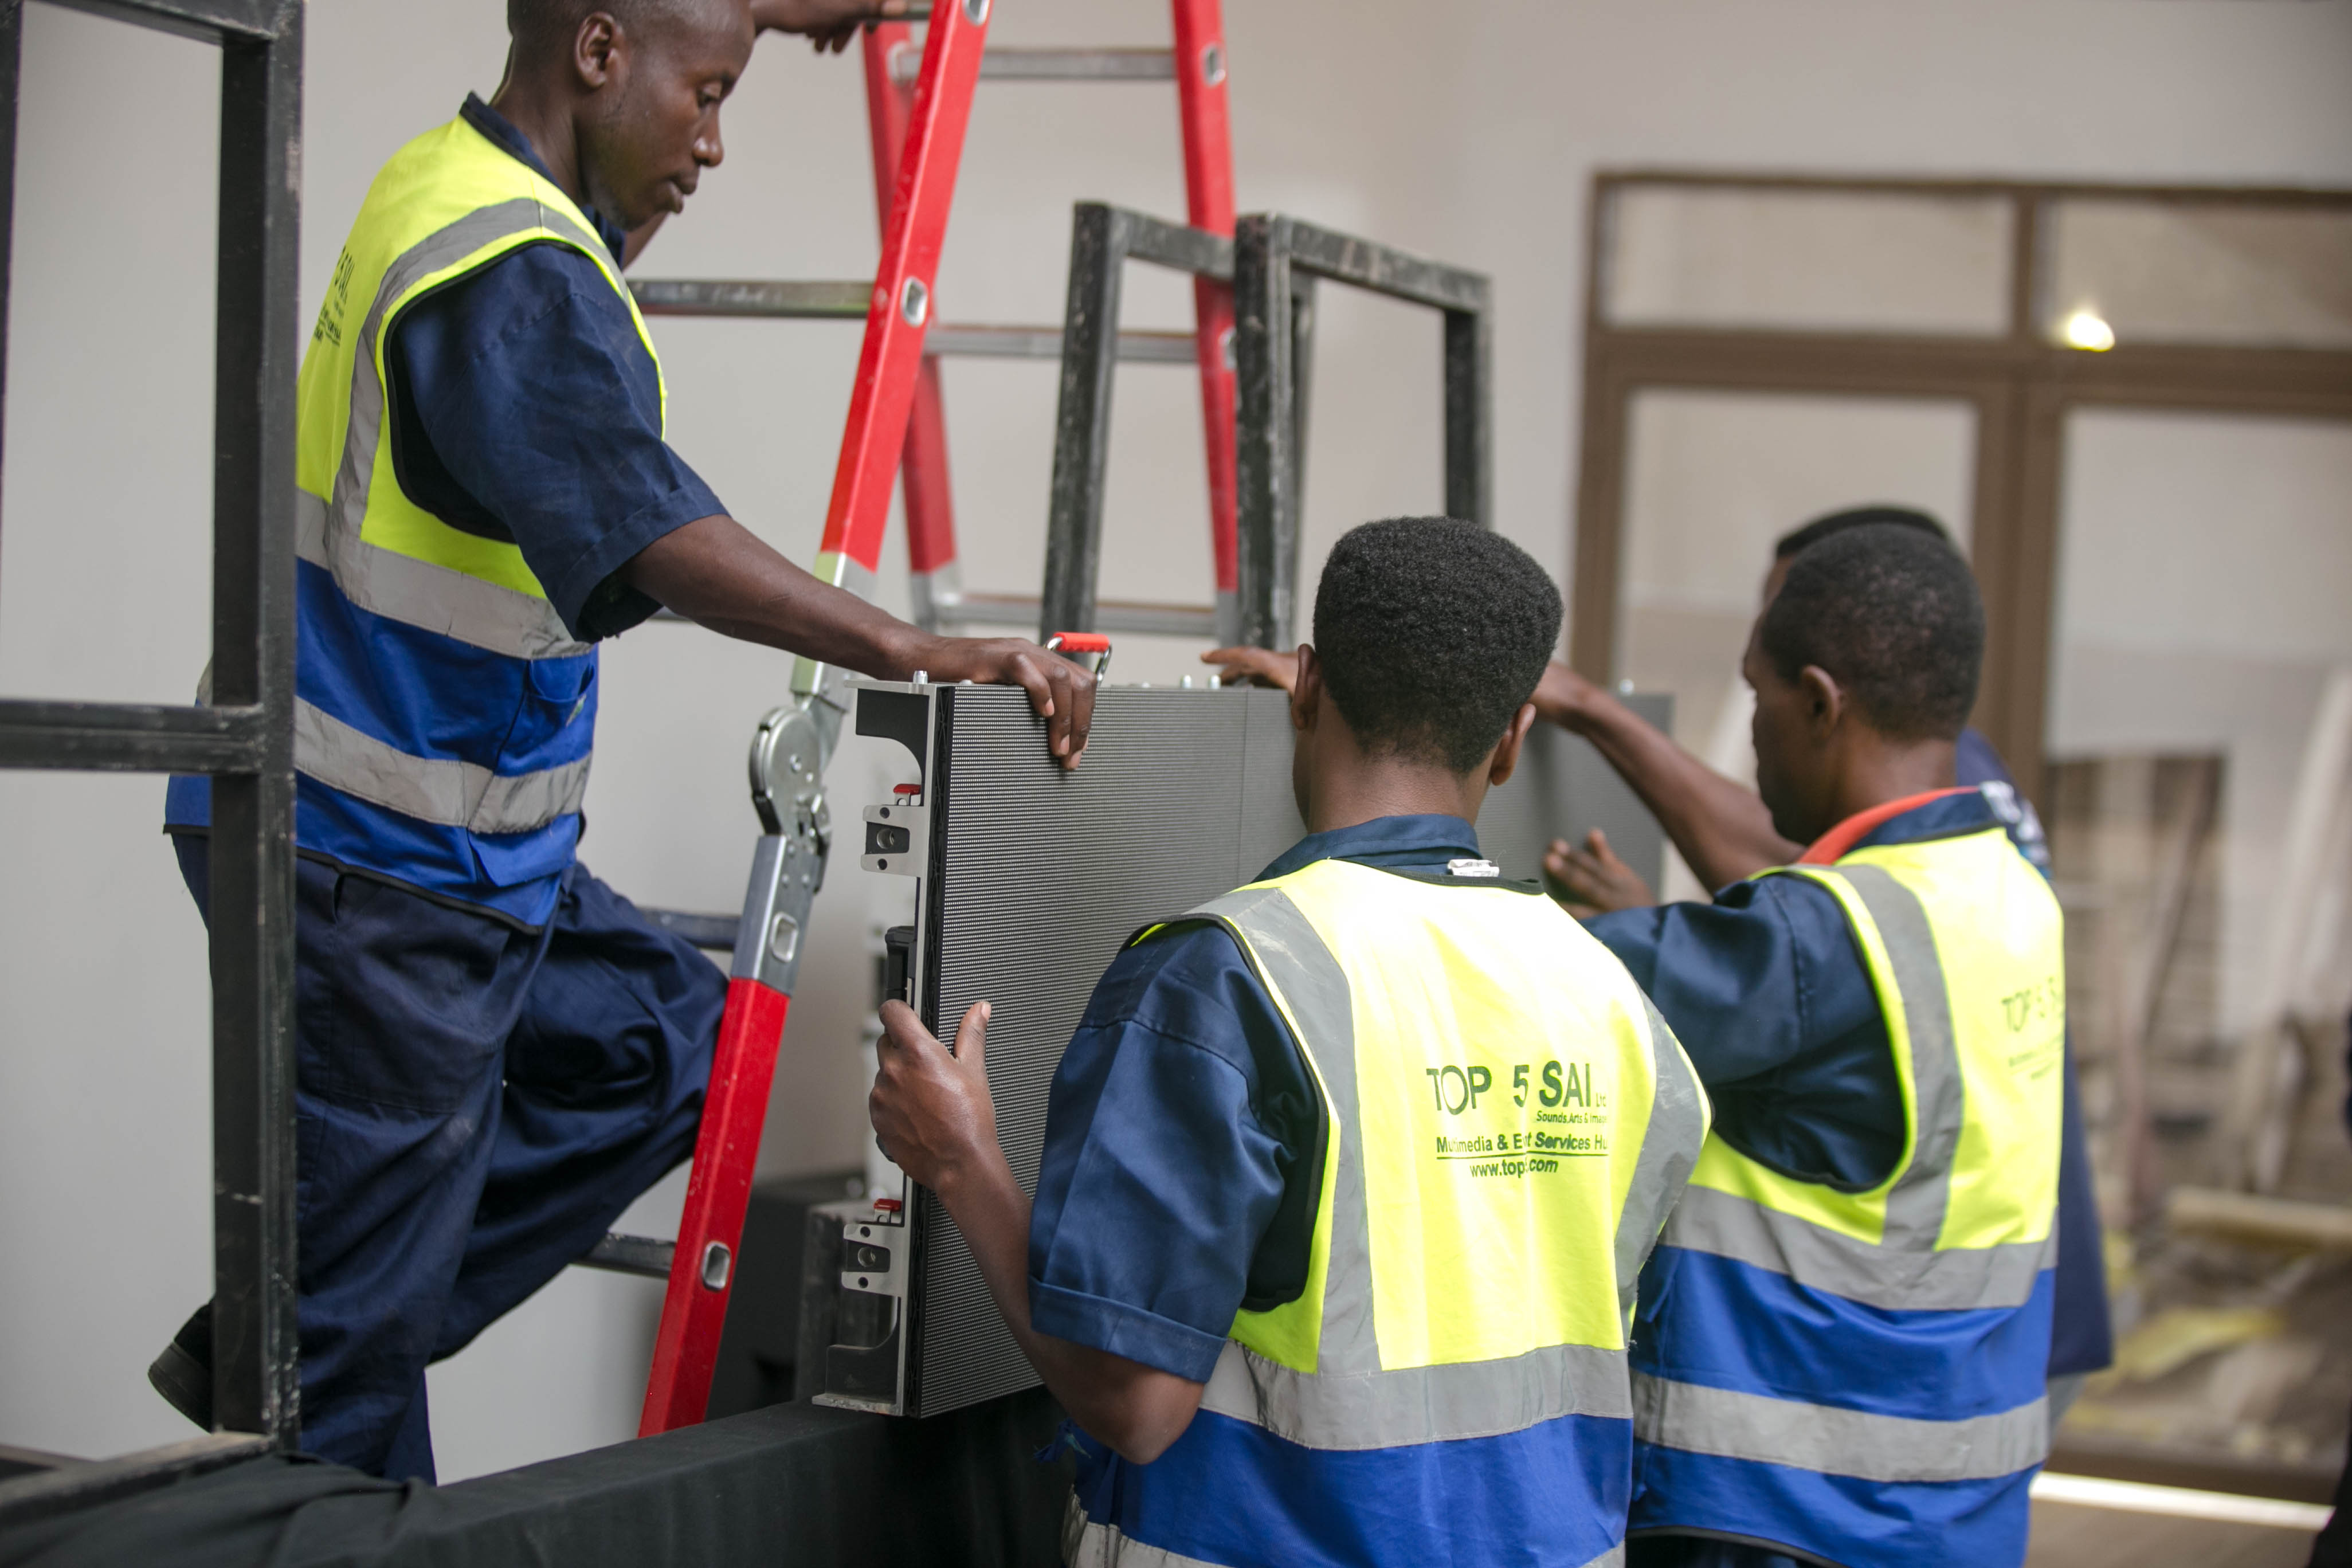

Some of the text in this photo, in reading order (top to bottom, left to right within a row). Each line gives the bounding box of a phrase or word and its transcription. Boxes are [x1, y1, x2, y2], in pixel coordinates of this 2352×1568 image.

[1425, 1065, 1492, 1115] TOP
[1513, 1064, 1530, 1108] 5
[1539, 1060, 1591, 1107] SAI
[1497, 1134, 1508, 1151] &
[1535, 1131, 1591, 1150] Services
